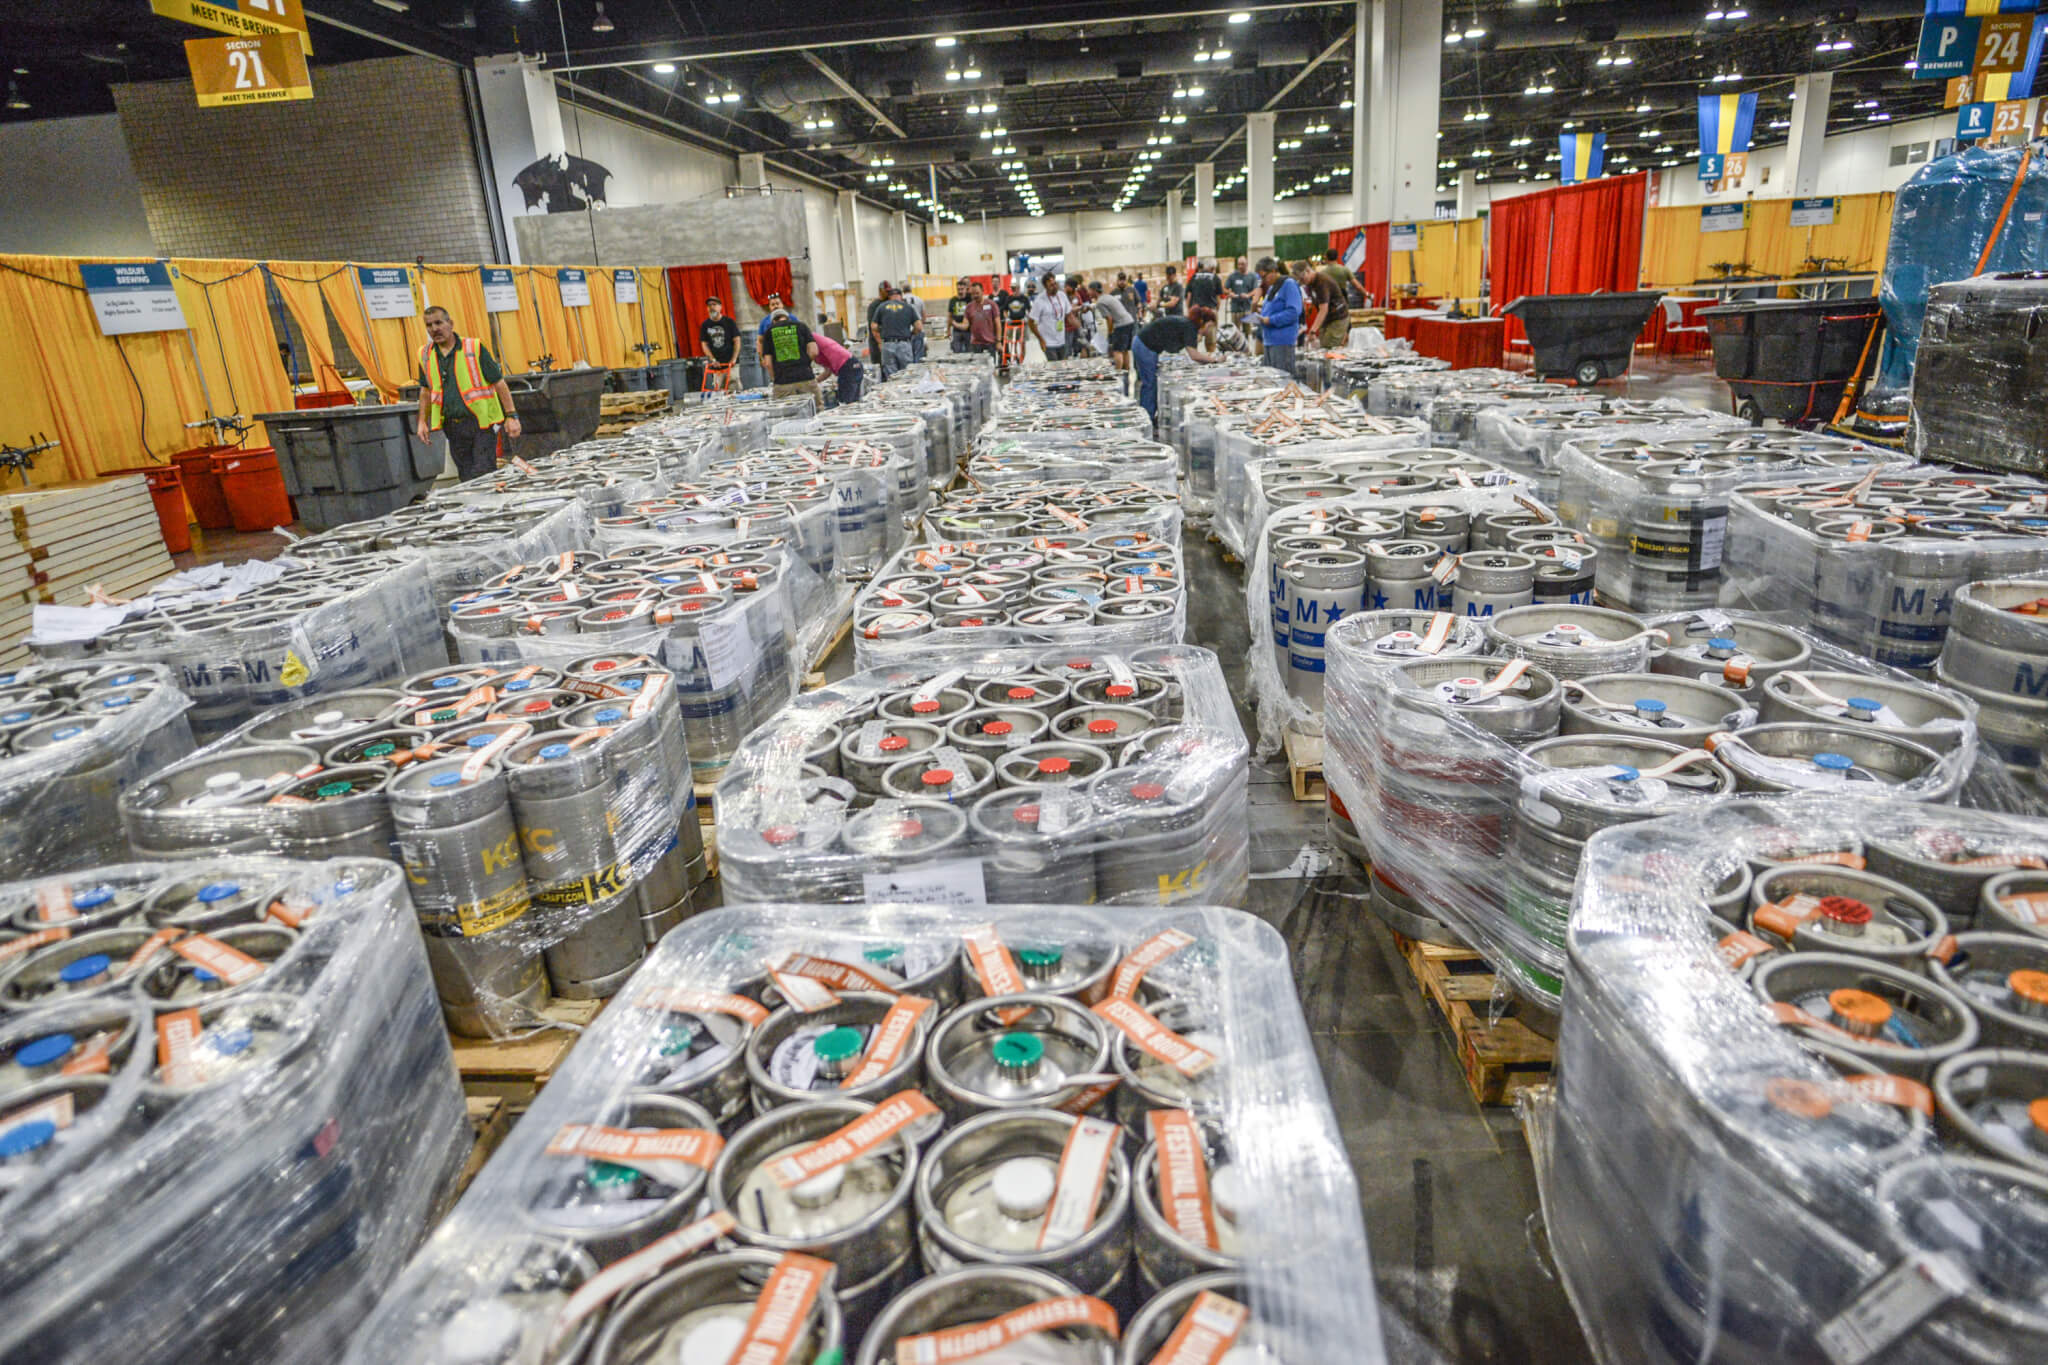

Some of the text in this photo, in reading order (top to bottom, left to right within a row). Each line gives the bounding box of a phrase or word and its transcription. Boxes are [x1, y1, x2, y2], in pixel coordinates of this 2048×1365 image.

[191, 3, 219, 21] MEET
[220, 12, 241, 28] THE
[225, 41, 262, 50] SECTION
[1938, 26, 1958, 57] P
[1981, 31, 2021, 66] 24
[229, 50, 267, 89] 21
[1923, 61, 1964, 70] BREWERIES
[222, 91, 288, 102] MEET THE BREWER
[1968, 108, 1982, 127] R
[1996, 110, 2020, 132] 25
[1706, 158, 1743, 177] S 26
[116, 276, 151, 285] BREWING
[1296, 597, 1318, 624] M
[1891, 586, 1926, 616] M
[183, 664, 211, 687] M
[244, 660, 270, 684] M
[871, 1009, 915, 1061] FESTIVAL
[1105, 1000, 1192, 1062] FESTIVAL BOOTH
[579, 1128, 701, 1157] FESTIVAL BOOTH
[797, 1099, 915, 1172] FESTIVAL BOOTH
[1163, 1123, 1199, 1197] FESTIVAL
[753, 1266, 814, 1342] FESTIVAL
[940, 1298, 1089, 1359] FESTIVAL BOOTH
